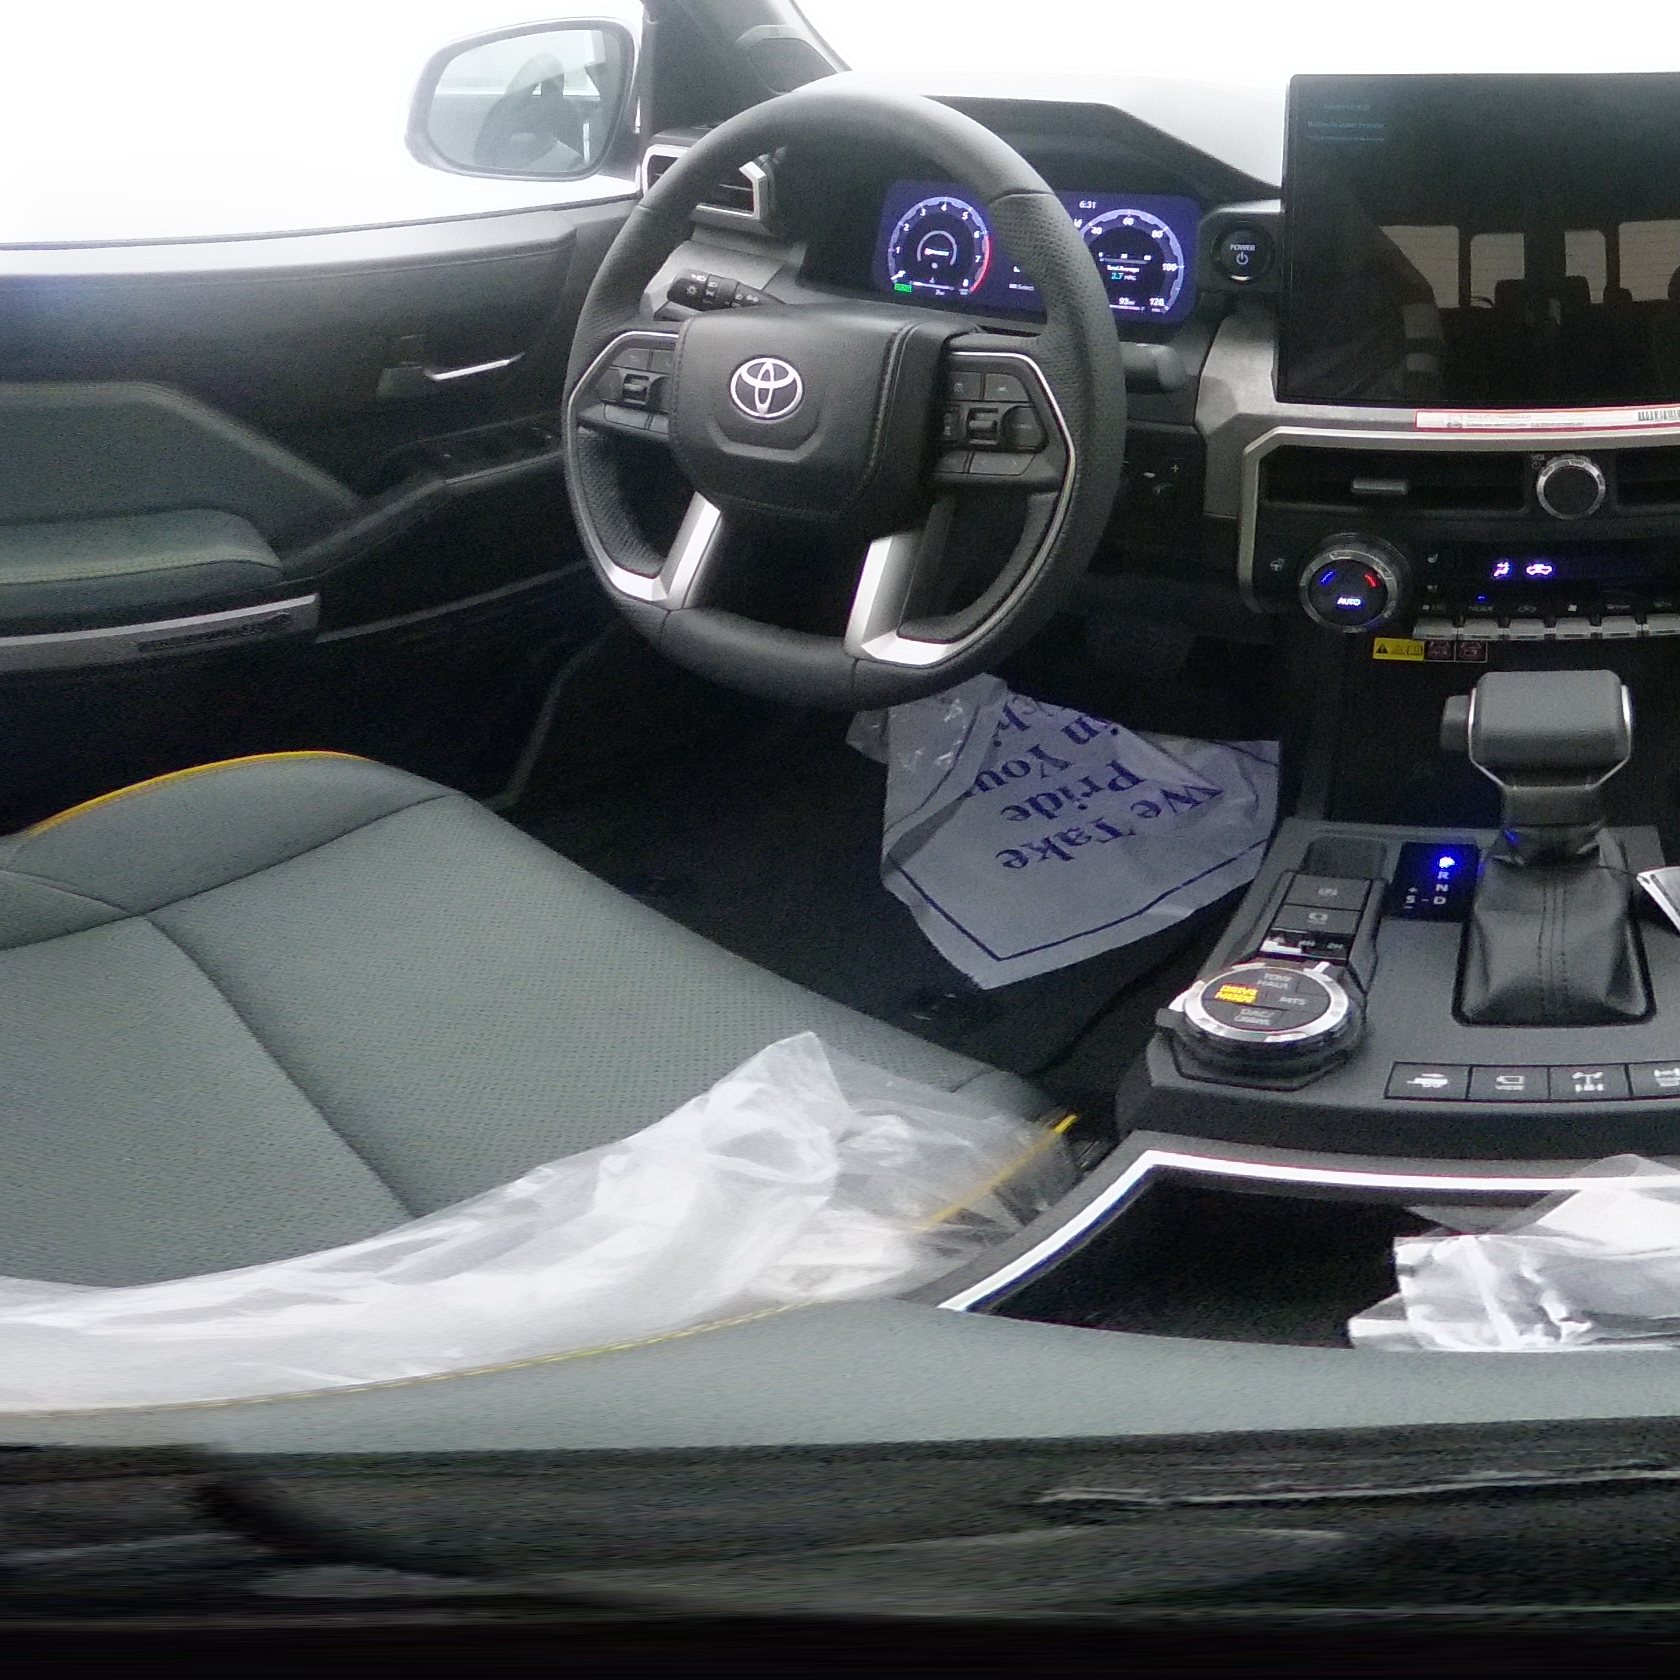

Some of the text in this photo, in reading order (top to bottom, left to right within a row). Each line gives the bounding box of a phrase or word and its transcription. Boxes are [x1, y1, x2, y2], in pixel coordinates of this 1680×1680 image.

[1229, 243, 1256, 252] POWER
[1337, 596, 1363, 607] AUTO
[1000, 760, 1147, 822] Pride
[995, 784, 1224, 870] We Take
[1437, 871, 1450, 880] R
[1435, 883, 1449, 893] N
[1405, 894, 1416, 904] S
[1433, 895, 1447, 905] D
